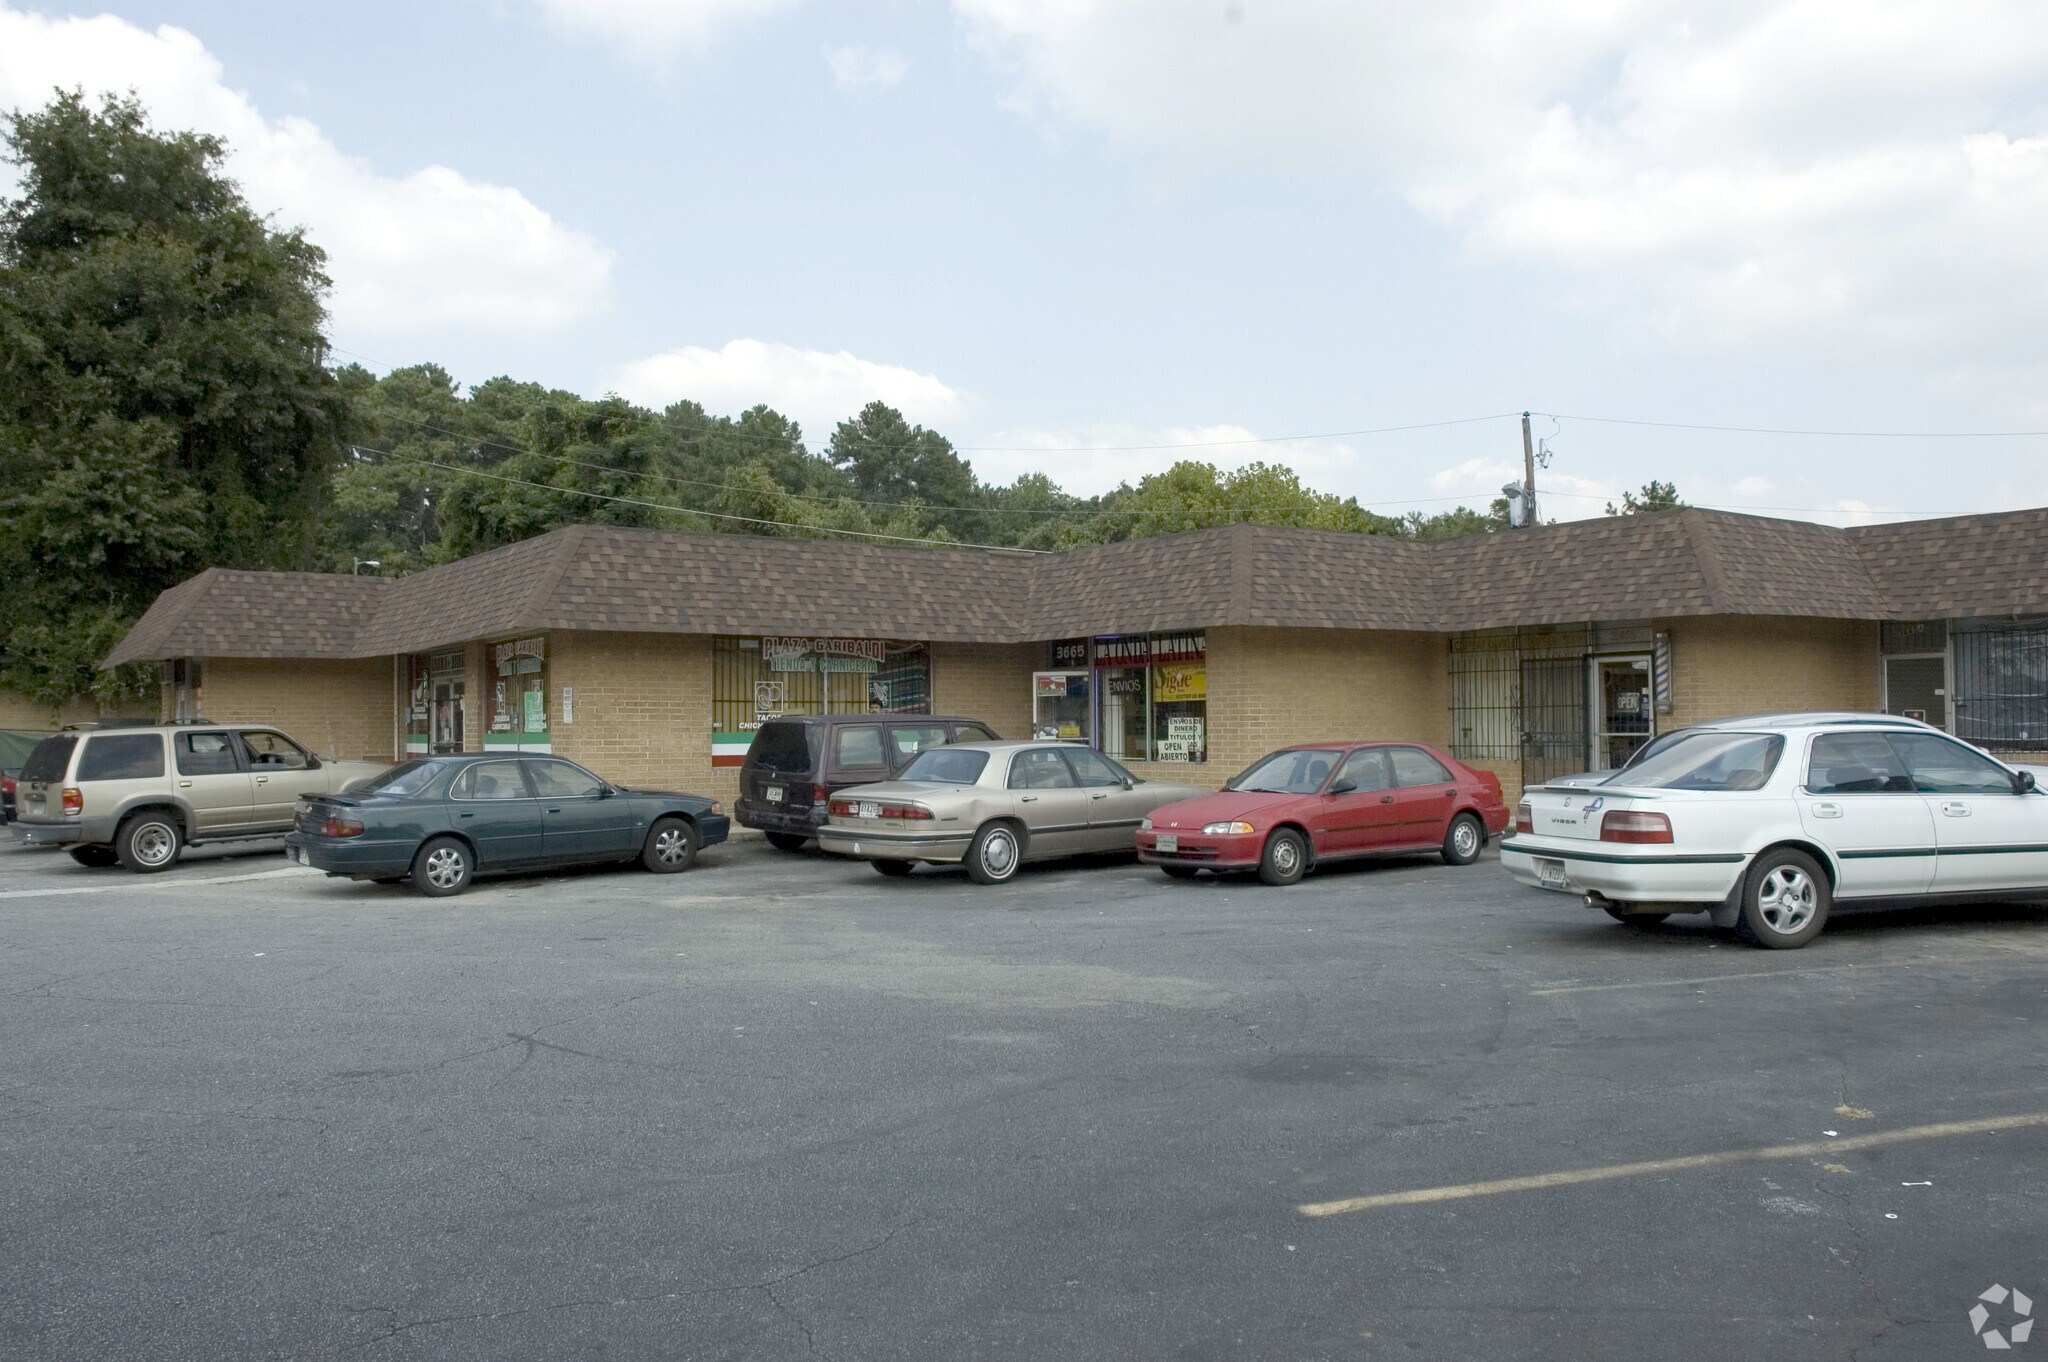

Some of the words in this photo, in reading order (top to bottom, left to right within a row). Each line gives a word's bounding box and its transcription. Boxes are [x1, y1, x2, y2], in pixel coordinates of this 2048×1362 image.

[763, 637, 809, 660] PLAZA
[815, 638, 885, 663] GARIBALDI
[1056, 645, 1084, 660] 3665
[771, 658, 806, 672] TIENDA
[808, 658, 816, 672] Y
[819, 658, 878, 673] CARNICERIA
[1155, 664, 1192, 693] Sigue
[1108, 679, 1141, 693] ENVIOS
[1617, 696, 1638, 709] OPEN
[1164, 742, 1182, 751] OPEN
[1160, 752, 1188, 761] ABIERTO
